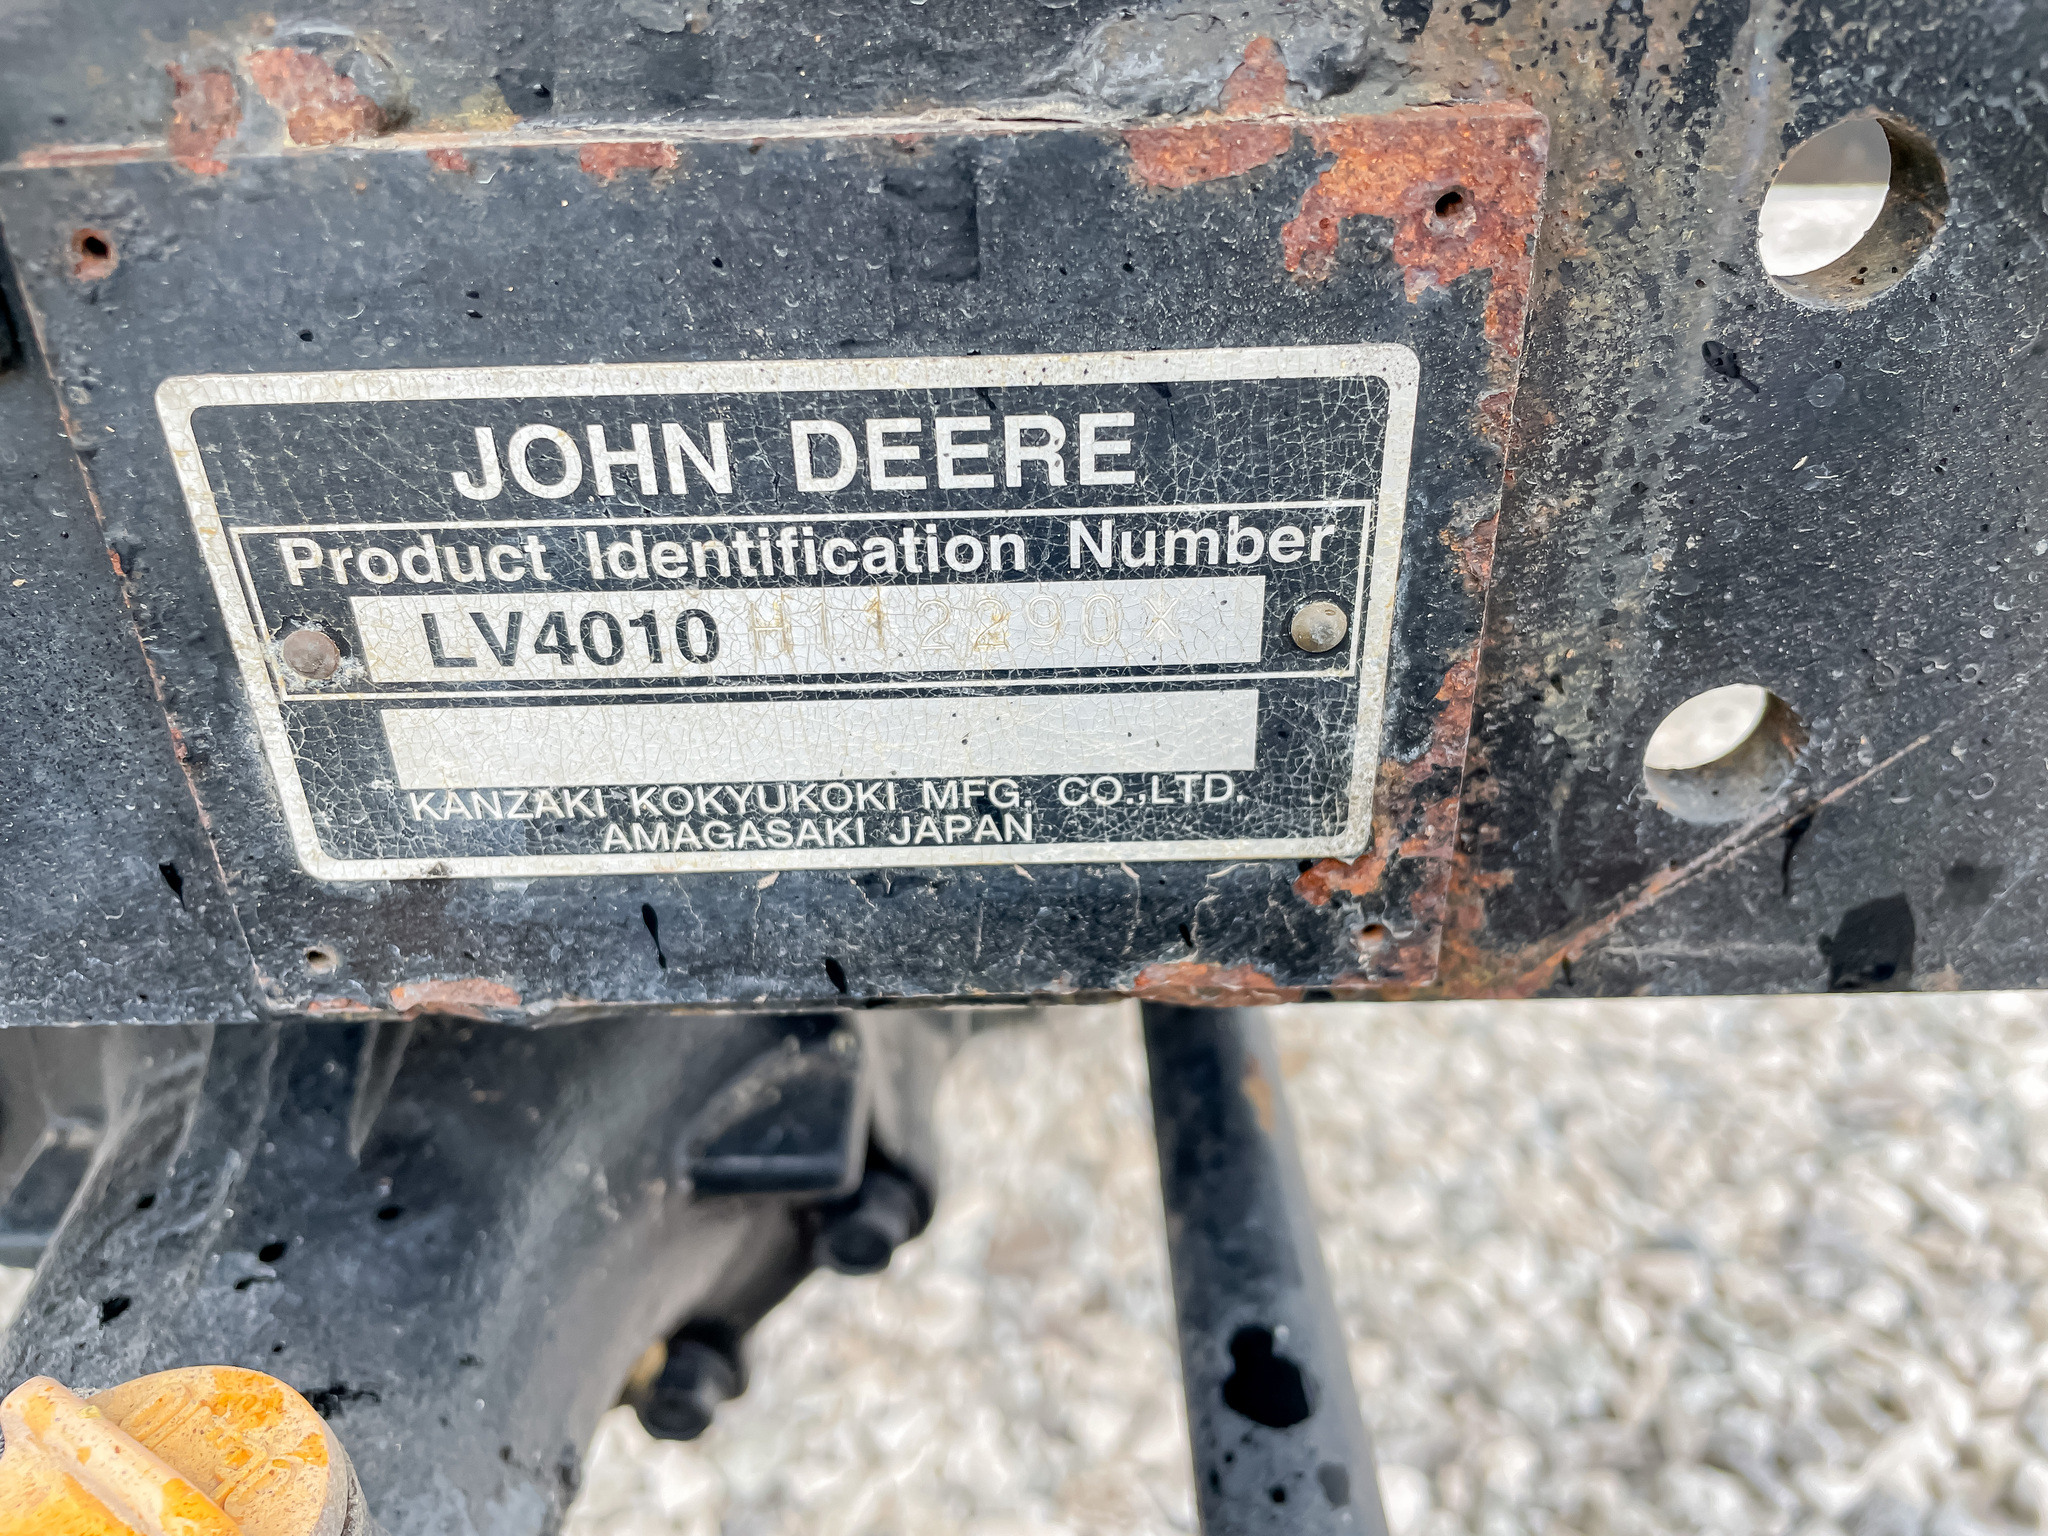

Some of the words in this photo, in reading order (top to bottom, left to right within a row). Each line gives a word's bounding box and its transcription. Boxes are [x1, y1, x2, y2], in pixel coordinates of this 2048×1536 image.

[452, 421, 733, 500] JOHN
[790, 412, 1137, 493] DEERE
[278, 534, 552, 586] Product
[585, 523, 1027, 580] Identification
[1069, 515, 1336, 569] Number
[409, 788, 605, 821] KANZAKI
[631, 781, 896, 817] KOKYUKOKI
[922, 777, 1033, 811] MFG.
[602, 816, 865, 853] AMAGASAKI
[888, 813, 1033, 846] JAPAN
